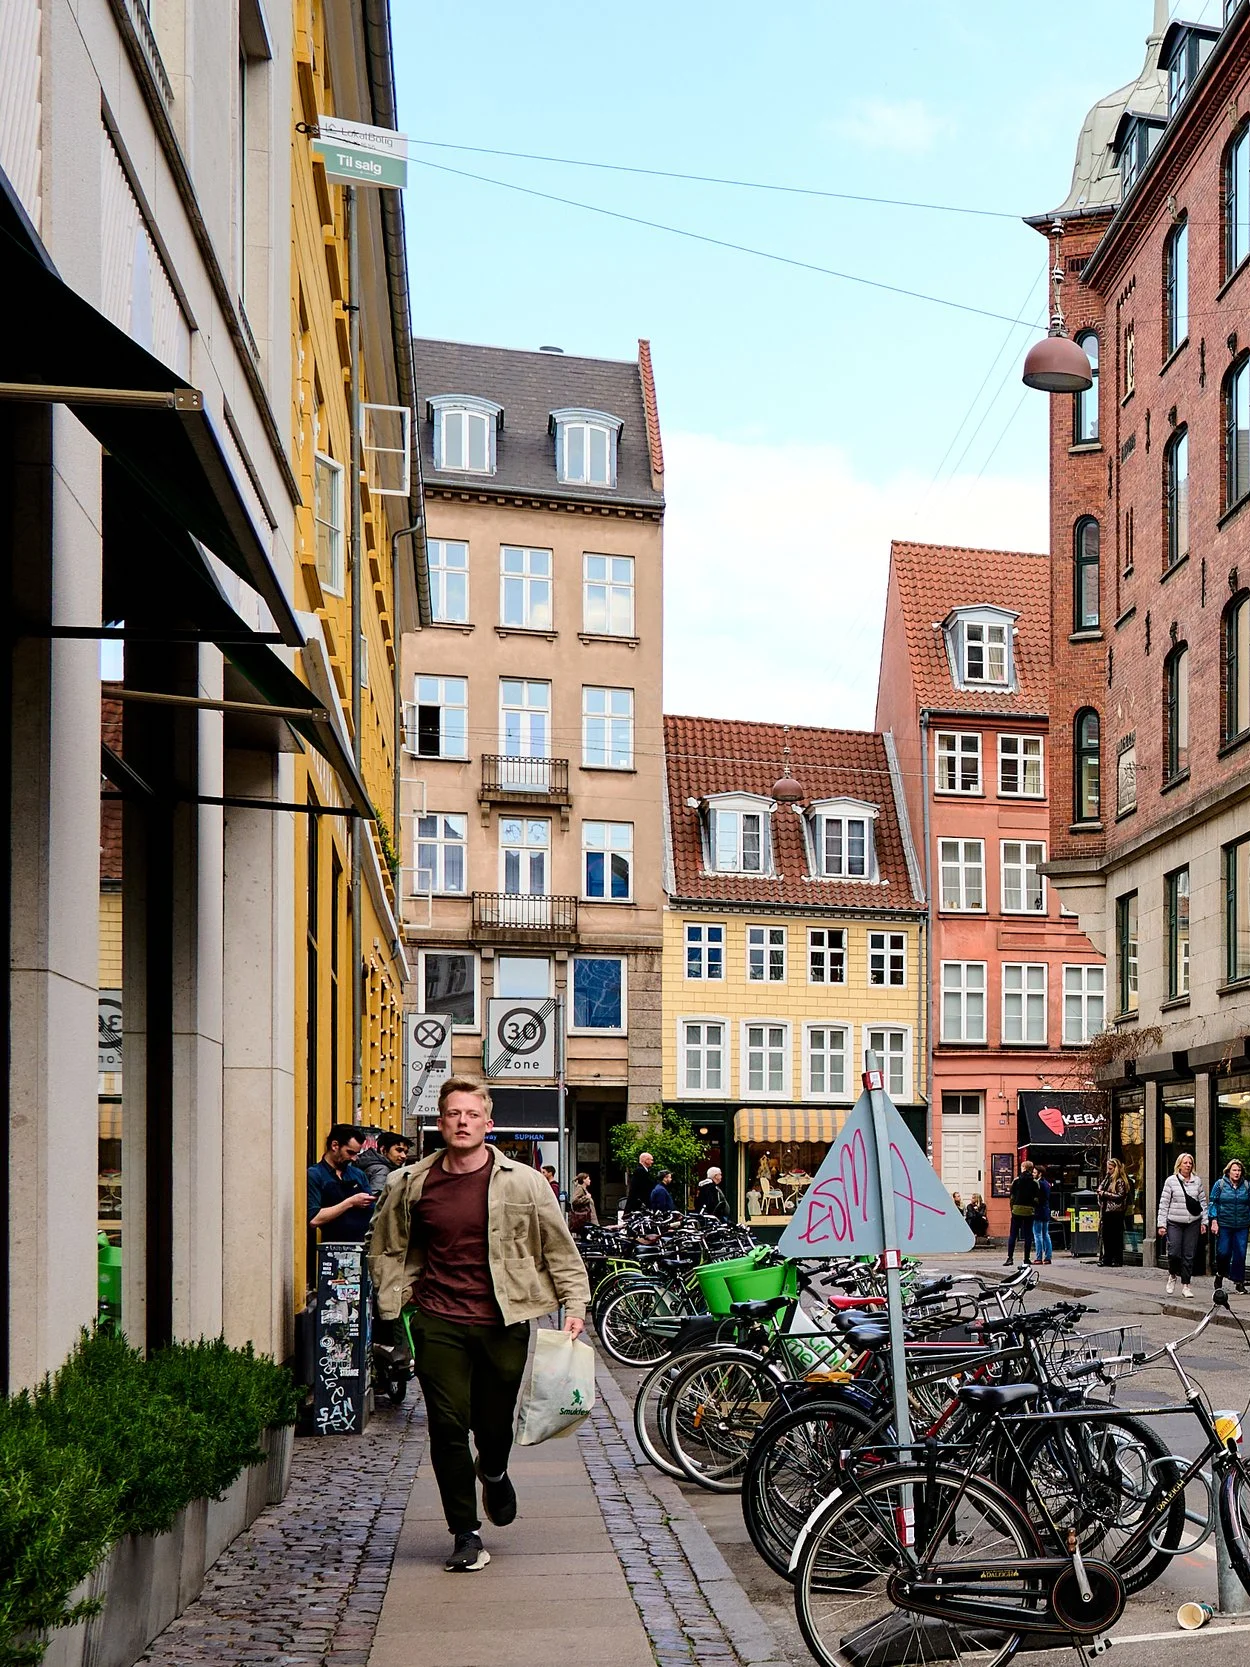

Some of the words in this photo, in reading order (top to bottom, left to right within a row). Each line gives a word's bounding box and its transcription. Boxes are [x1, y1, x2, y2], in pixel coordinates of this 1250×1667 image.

[336, 153, 353, 168] Til
[355, 160, 382, 175] salg
[507, 1022, 537, 1041] 30
[504, 1059, 540, 1070] Zone
[1062, 1113, 1106, 1125] KEBA
[1157, 1480, 1186, 1512] RALEIGH
